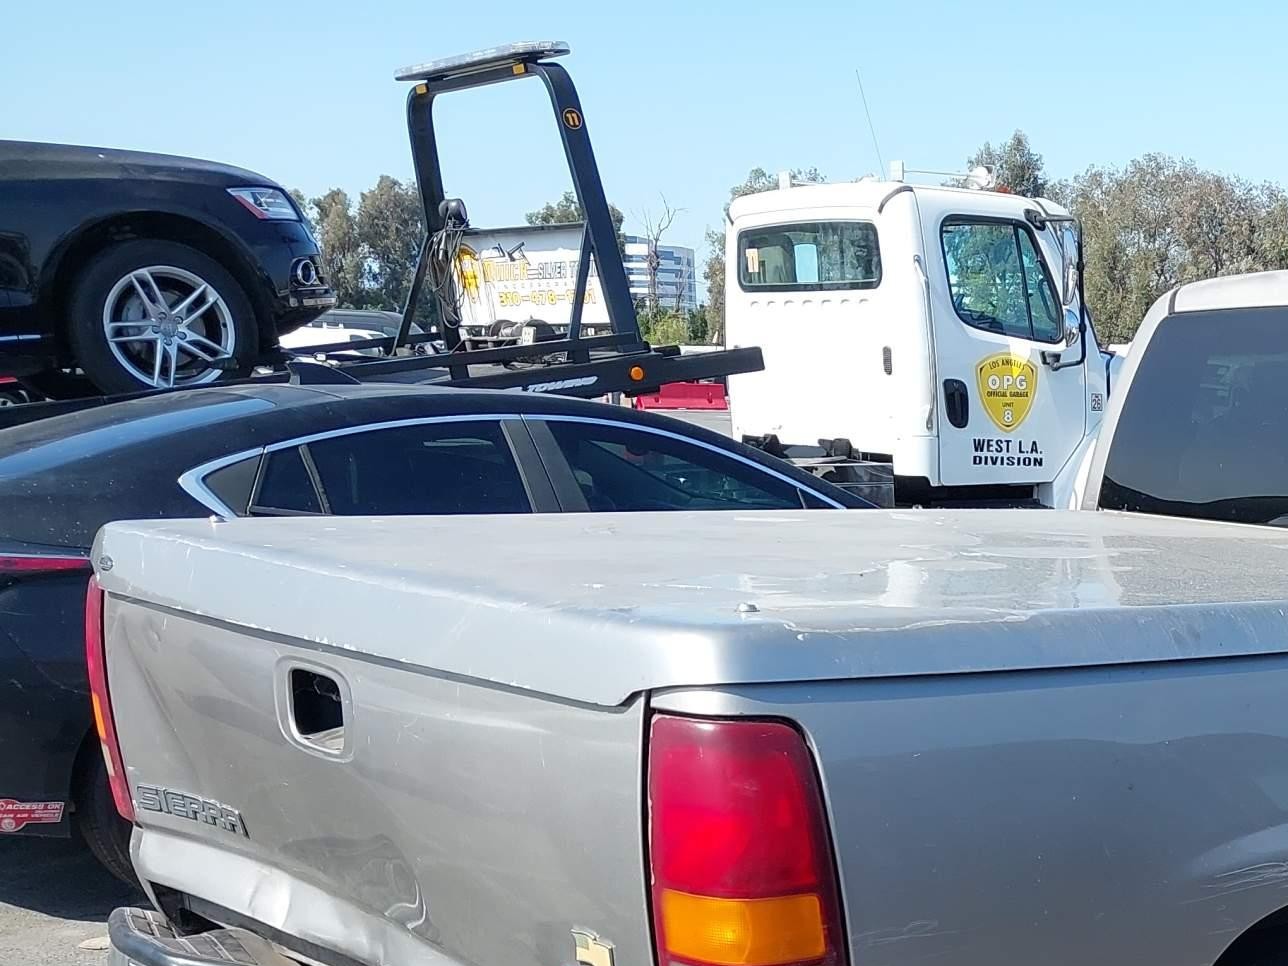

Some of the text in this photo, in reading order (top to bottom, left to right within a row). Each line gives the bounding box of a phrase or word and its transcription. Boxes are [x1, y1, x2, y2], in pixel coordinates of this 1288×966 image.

[565, 112, 580, 126] 11
[988, 359, 1000, 370] LOS
[987, 374, 1028, 391] OPG
[1003, 409, 1013, 423] 8
[972, 438, 1043, 454] WEST L.A.
[972, 455, 1043, 467] DIVISION
[136, 784, 250, 840] SIERRA
